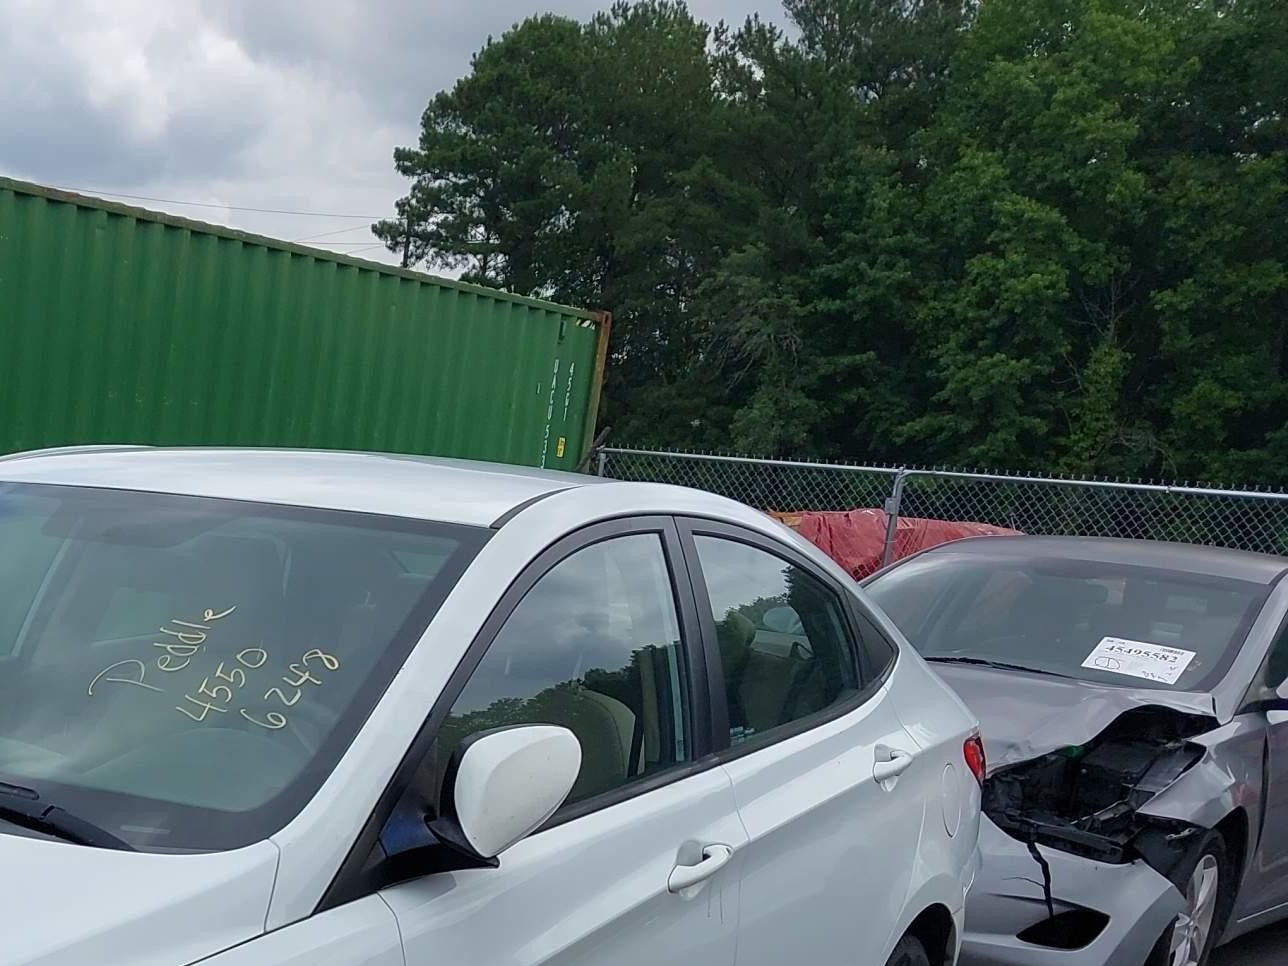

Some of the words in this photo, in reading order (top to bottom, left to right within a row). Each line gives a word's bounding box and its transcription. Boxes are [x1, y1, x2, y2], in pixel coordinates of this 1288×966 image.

[89, 606, 236, 695] Peddle
[176, 648, 268, 721] 4550
[240, 649, 340, 728] 6248
